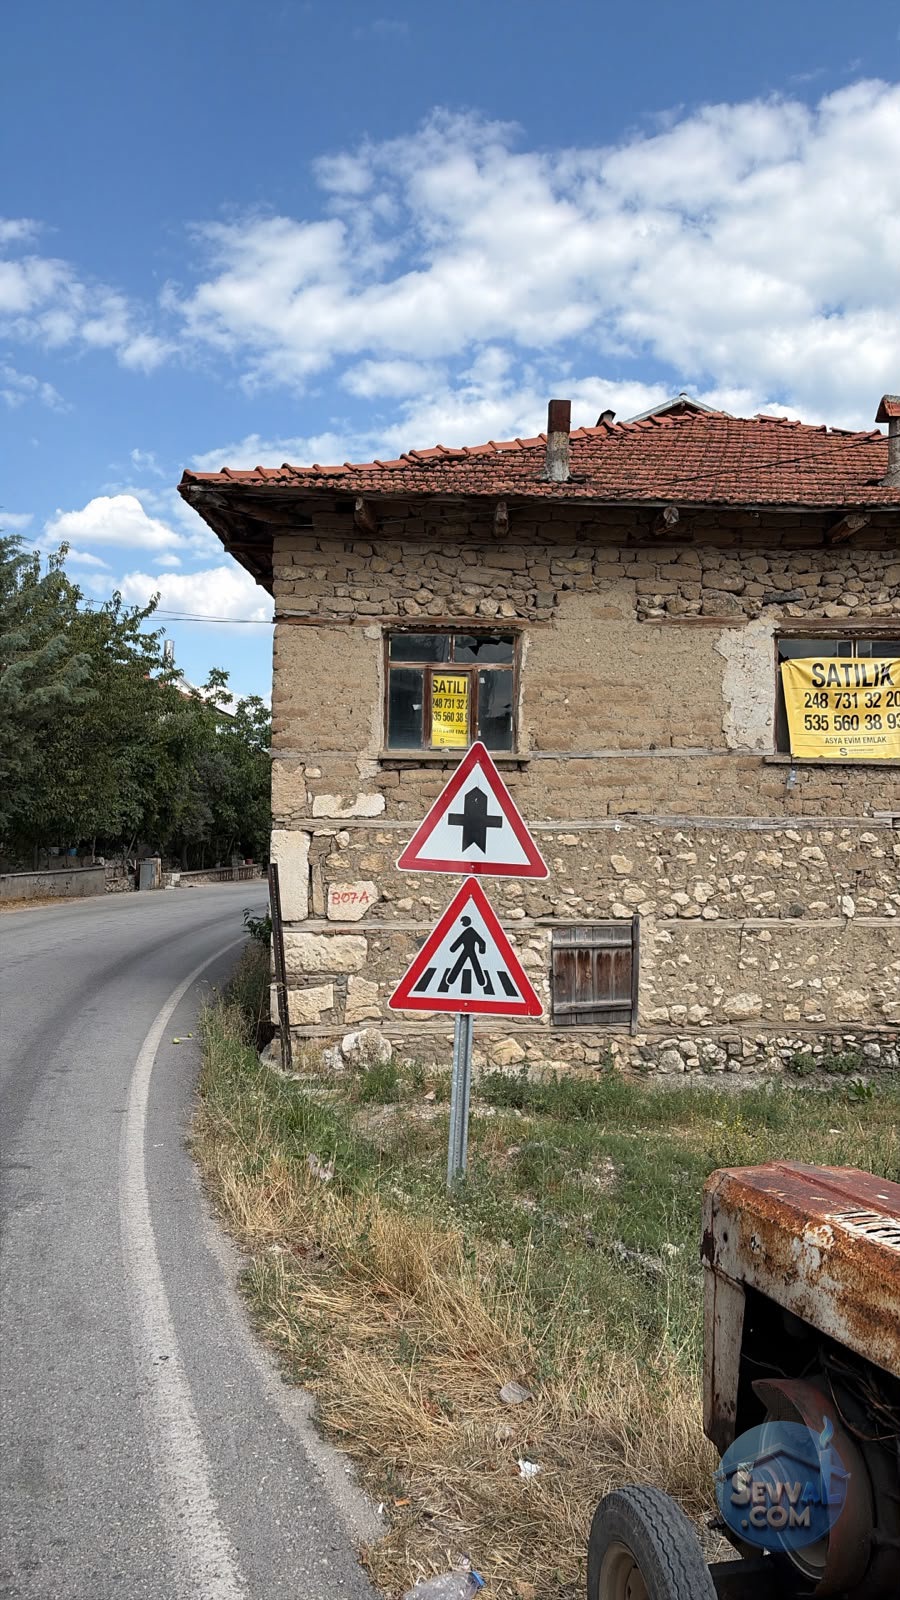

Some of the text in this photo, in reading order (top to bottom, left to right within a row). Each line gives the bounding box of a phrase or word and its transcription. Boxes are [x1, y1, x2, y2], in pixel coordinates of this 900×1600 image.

[812, 663, 895, 688] SATILIK
[444, 699, 454, 708] 731
[456, 699, 464, 709] 32
[804, 691, 900, 709] 248 731 32 20
[433, 711, 441, 721] 35
[443, 712, 454, 722] 560
[456, 712, 463, 722] 38
[805, 714, 829, 731] 535
[834, 714, 859, 731] 560
[865, 714, 882, 730] 38
